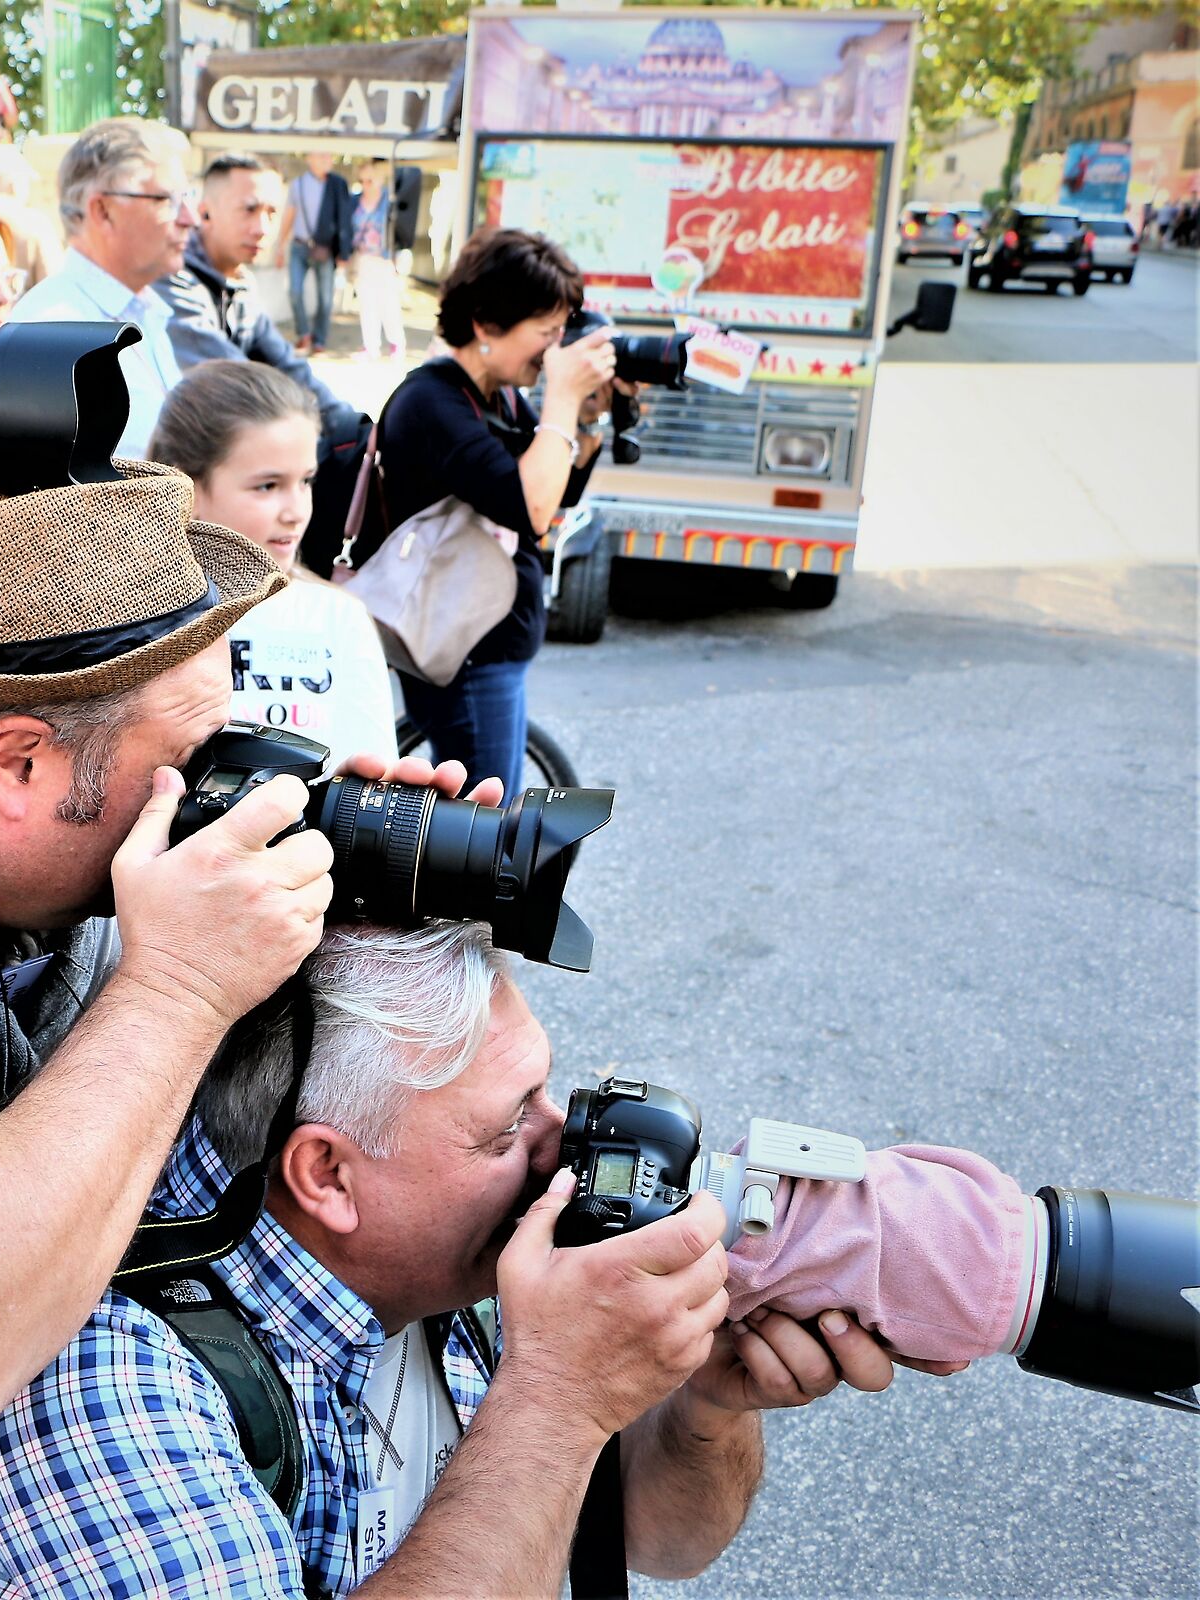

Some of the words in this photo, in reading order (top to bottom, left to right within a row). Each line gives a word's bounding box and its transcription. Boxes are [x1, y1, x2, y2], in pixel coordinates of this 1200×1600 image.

[207, 75, 449, 134] GELATI
[670, 147, 858, 199] Bibite
[666, 207, 847, 278] Gelati
[160, 1287, 194, 1298] NORTH
[170, 1280, 190, 1288] THE
[174, 1294, 197, 1303] FACE
